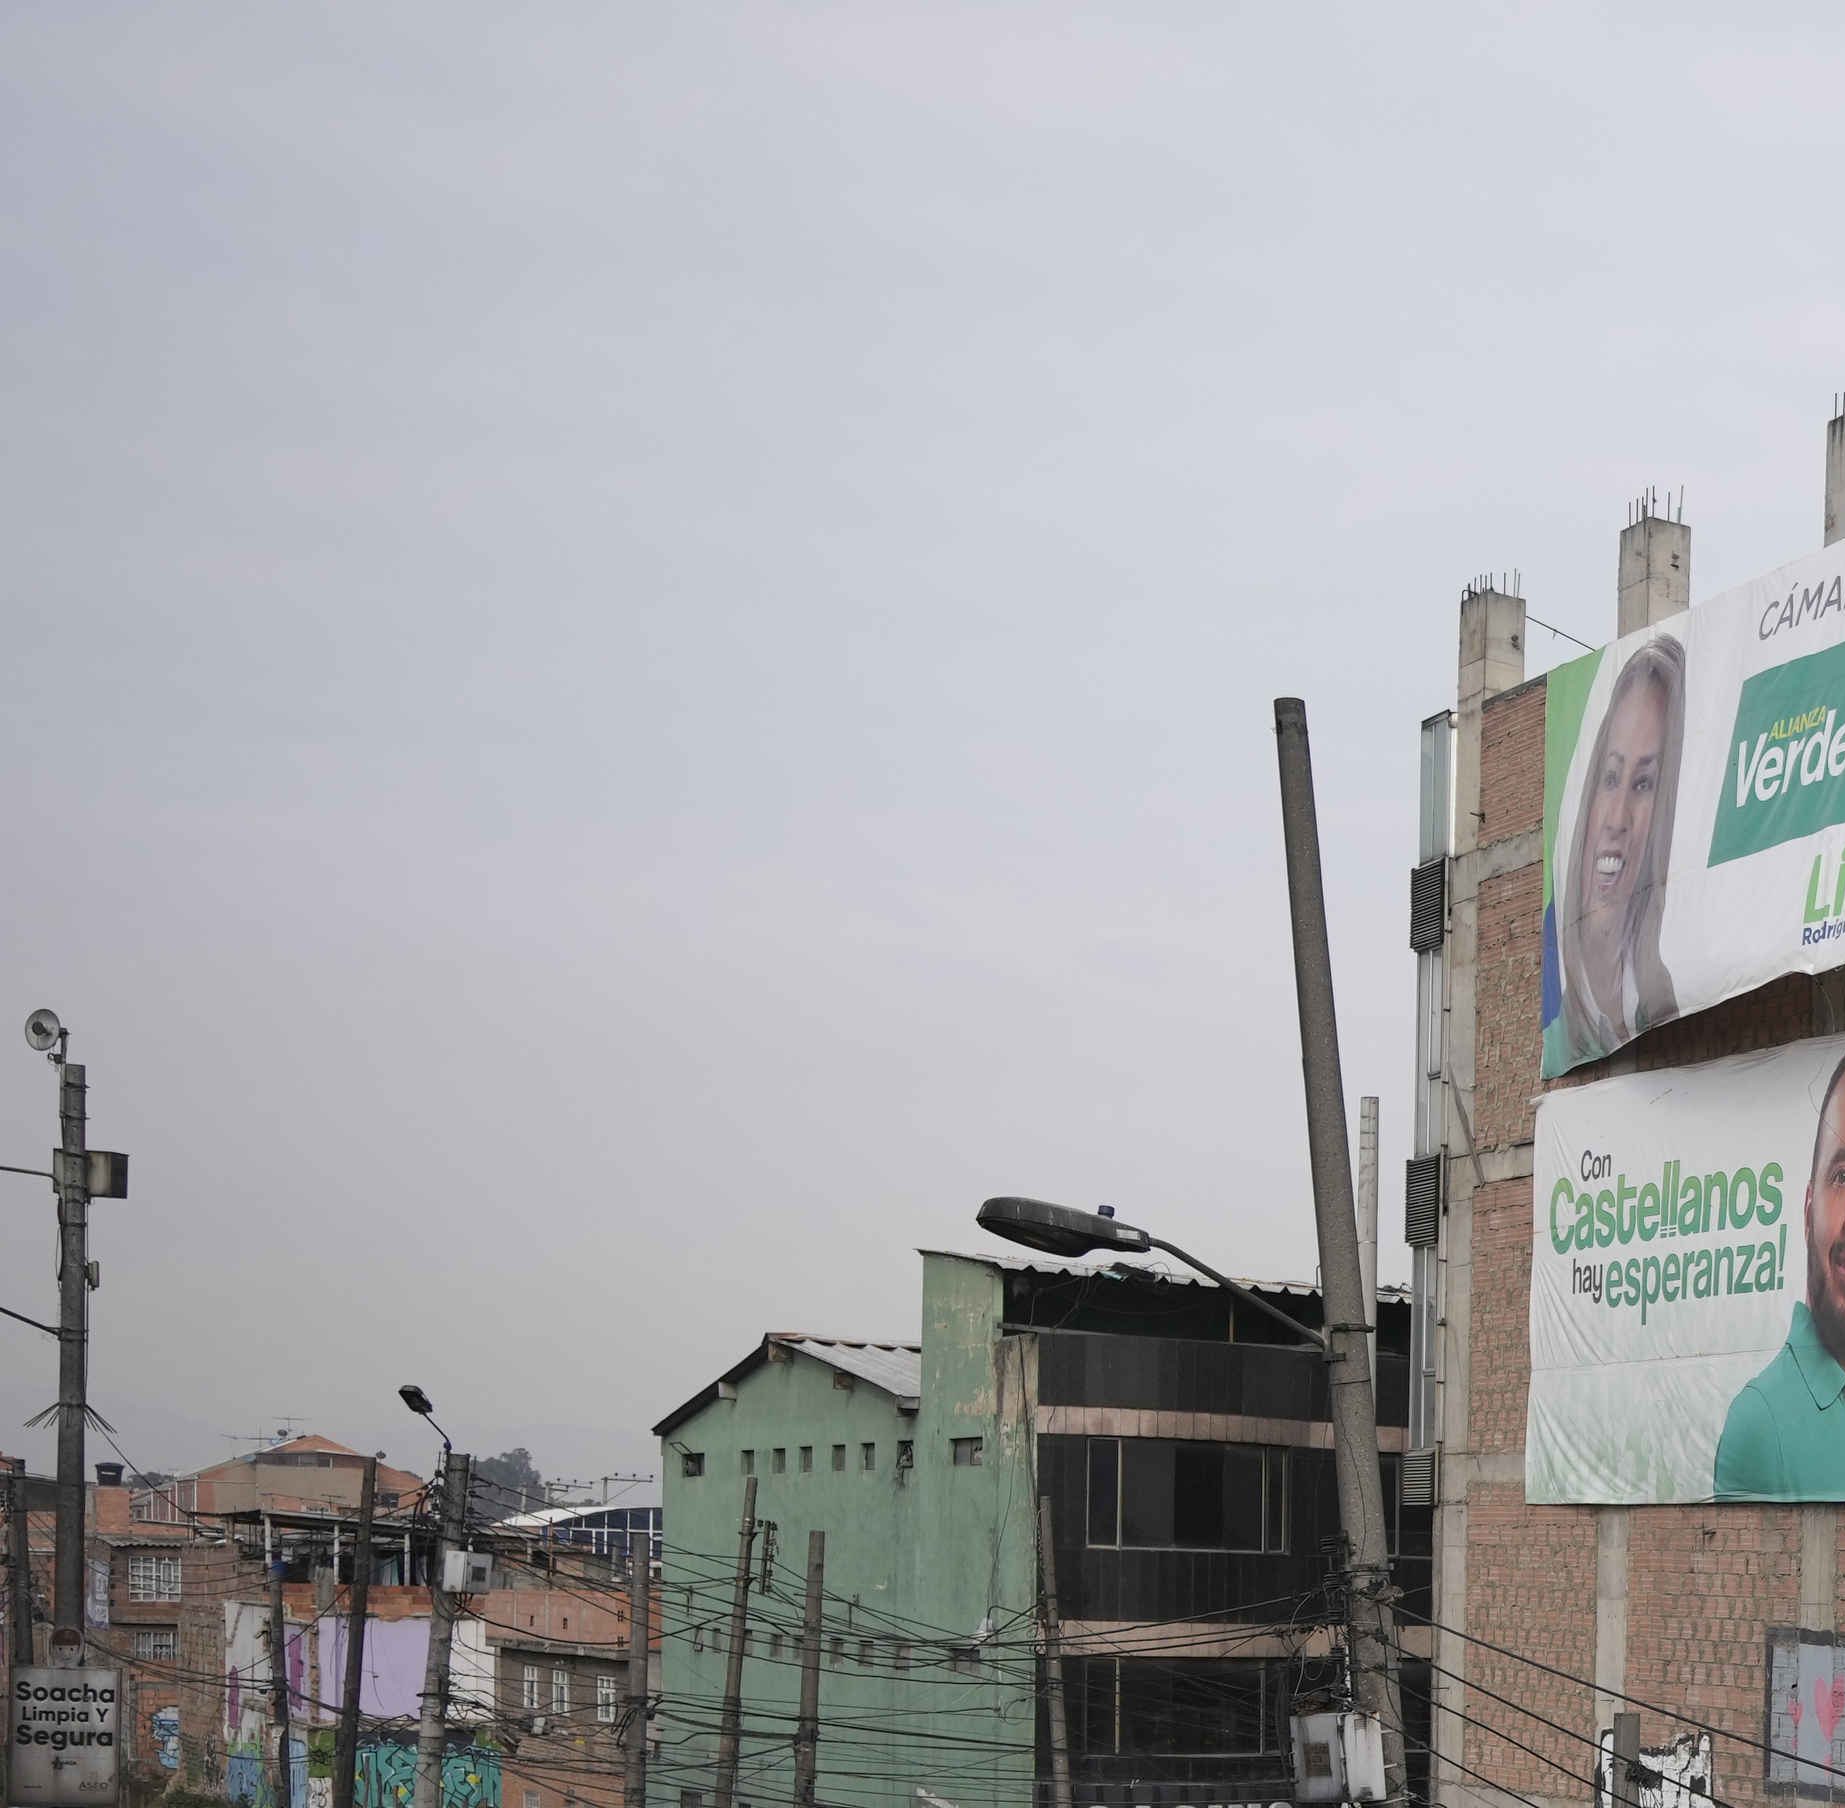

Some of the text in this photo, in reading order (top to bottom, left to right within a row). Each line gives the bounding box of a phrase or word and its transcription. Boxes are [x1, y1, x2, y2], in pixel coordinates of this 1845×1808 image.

[1767, 705, 1827, 742] ALIANZA
[1580, 1150, 1612, 1181] Con
[1550, 1160, 1784, 1254] Castellanos
[1572, 1224, 1787, 1325] hay esperanza!
[15, 1681, 115, 1703] Soacha
[22, 1706, 109, 1725] Limpia Y
[16, 1724, 113, 1751] Segura
